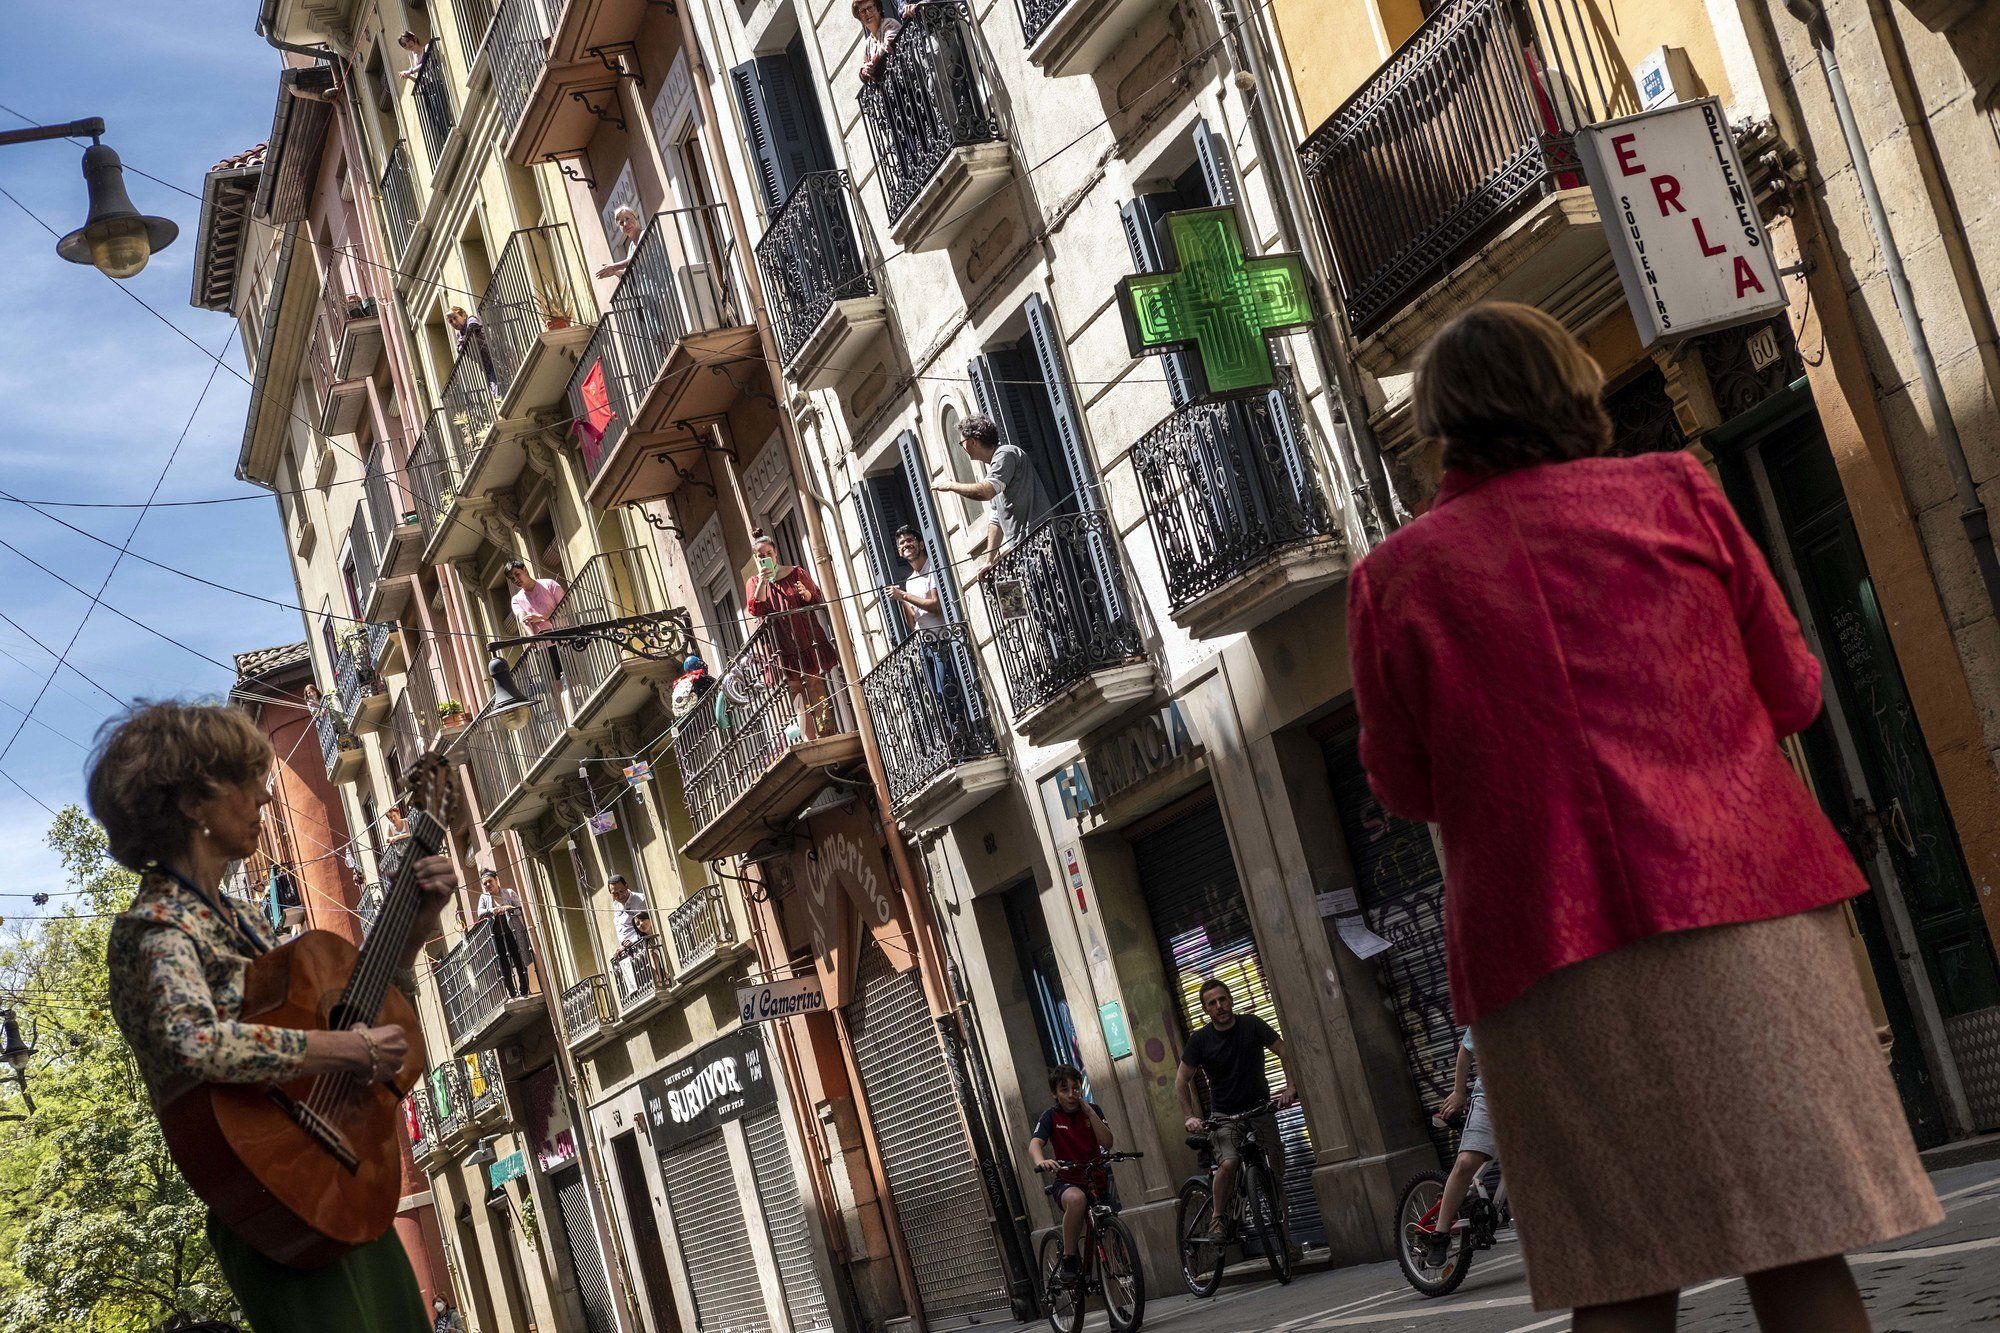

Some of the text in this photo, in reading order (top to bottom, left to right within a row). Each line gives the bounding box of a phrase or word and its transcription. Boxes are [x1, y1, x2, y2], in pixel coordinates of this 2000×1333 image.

[1611, 133, 1765, 299] ERLA
[1702, 106, 1760, 247] BELENES
[1620, 196, 1671, 329] SOUVENIRS
[1751, 339, 1774, 367] 60
[805, 832, 890, 923] Camerino
[743, 986, 821, 1020] el Camerino
[667, 1056, 743, 1123] SURVIVOR
